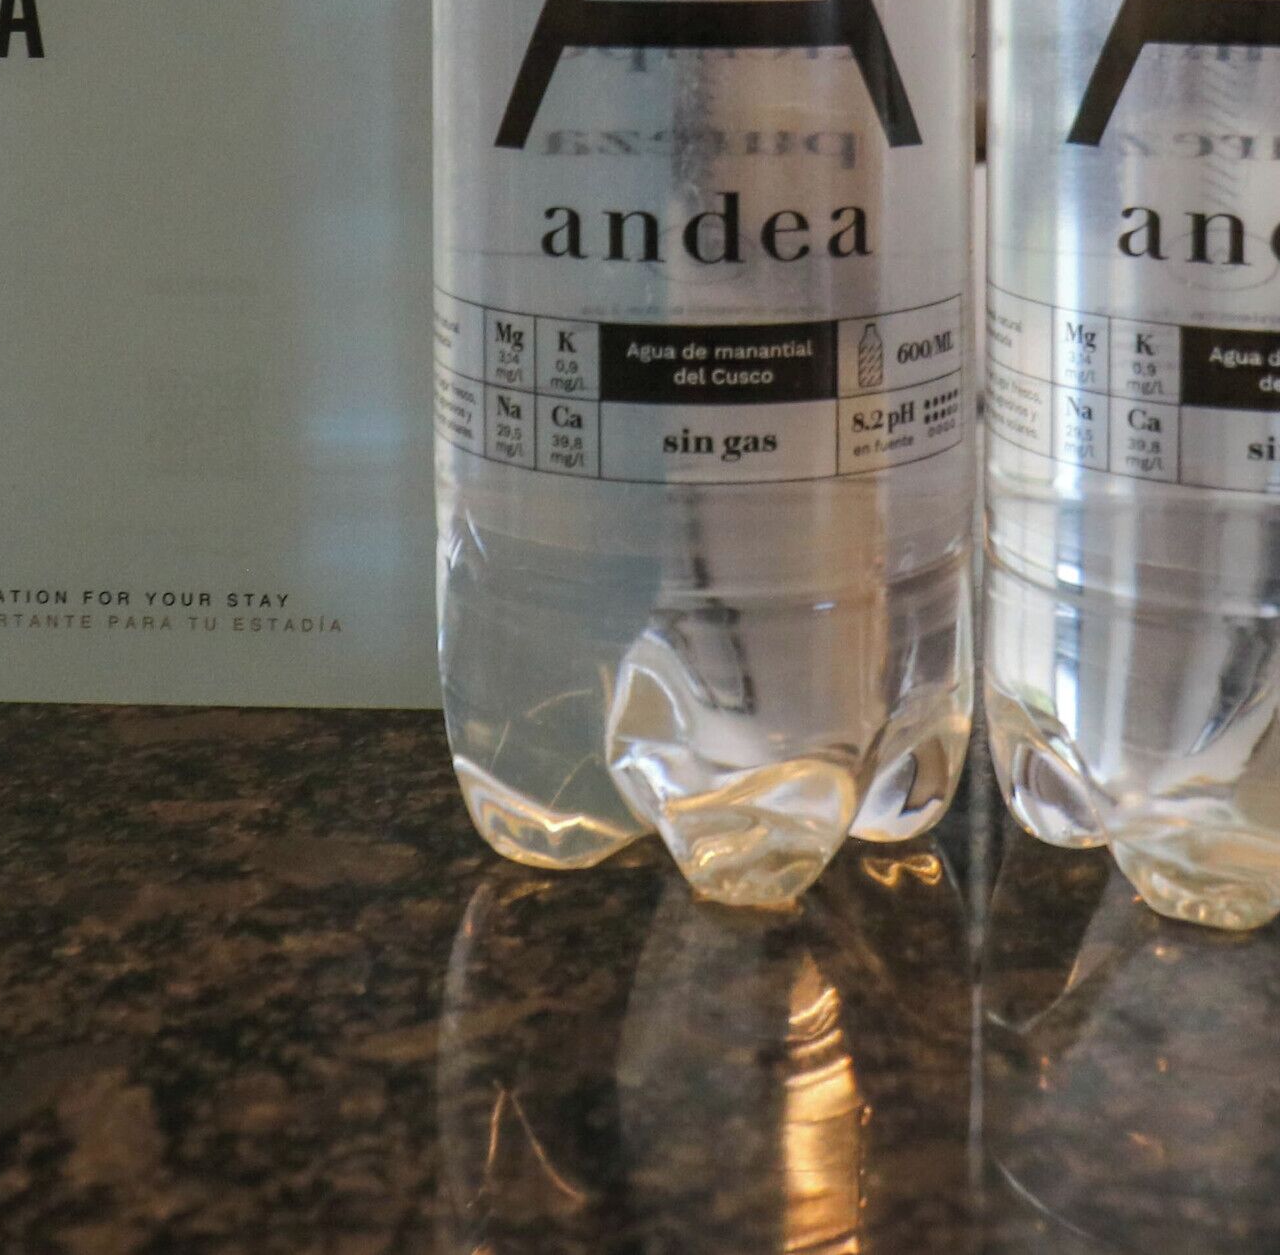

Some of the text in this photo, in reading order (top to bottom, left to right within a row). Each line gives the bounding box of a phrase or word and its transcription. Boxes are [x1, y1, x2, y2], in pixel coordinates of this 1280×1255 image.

[540, 191, 875, 265] andea
[495, 321, 524, 353] Mg
[558, 331, 577, 353] K
[1135, 332, 1154, 356] K
[627, 339, 815, 363] Agua de manantial
[896, 340, 933, 365] 600
[1208, 345, 1262, 368] Agua
[673, 367, 775, 386] del Cusco
[496, 395, 522, 421] Na
[551, 405, 583, 429] Ca
[851, 400, 915, 434] 8.2 pH
[1127, 408, 1162, 434] Ca
[662, 428, 778, 463] sin gas
[82, 590, 131, 607] FOR
[145, 592, 212, 608] YOUR
[226, 593, 290, 609] STAY
[108, 615, 172, 631] PARA
[188, 616, 217, 632] TU
